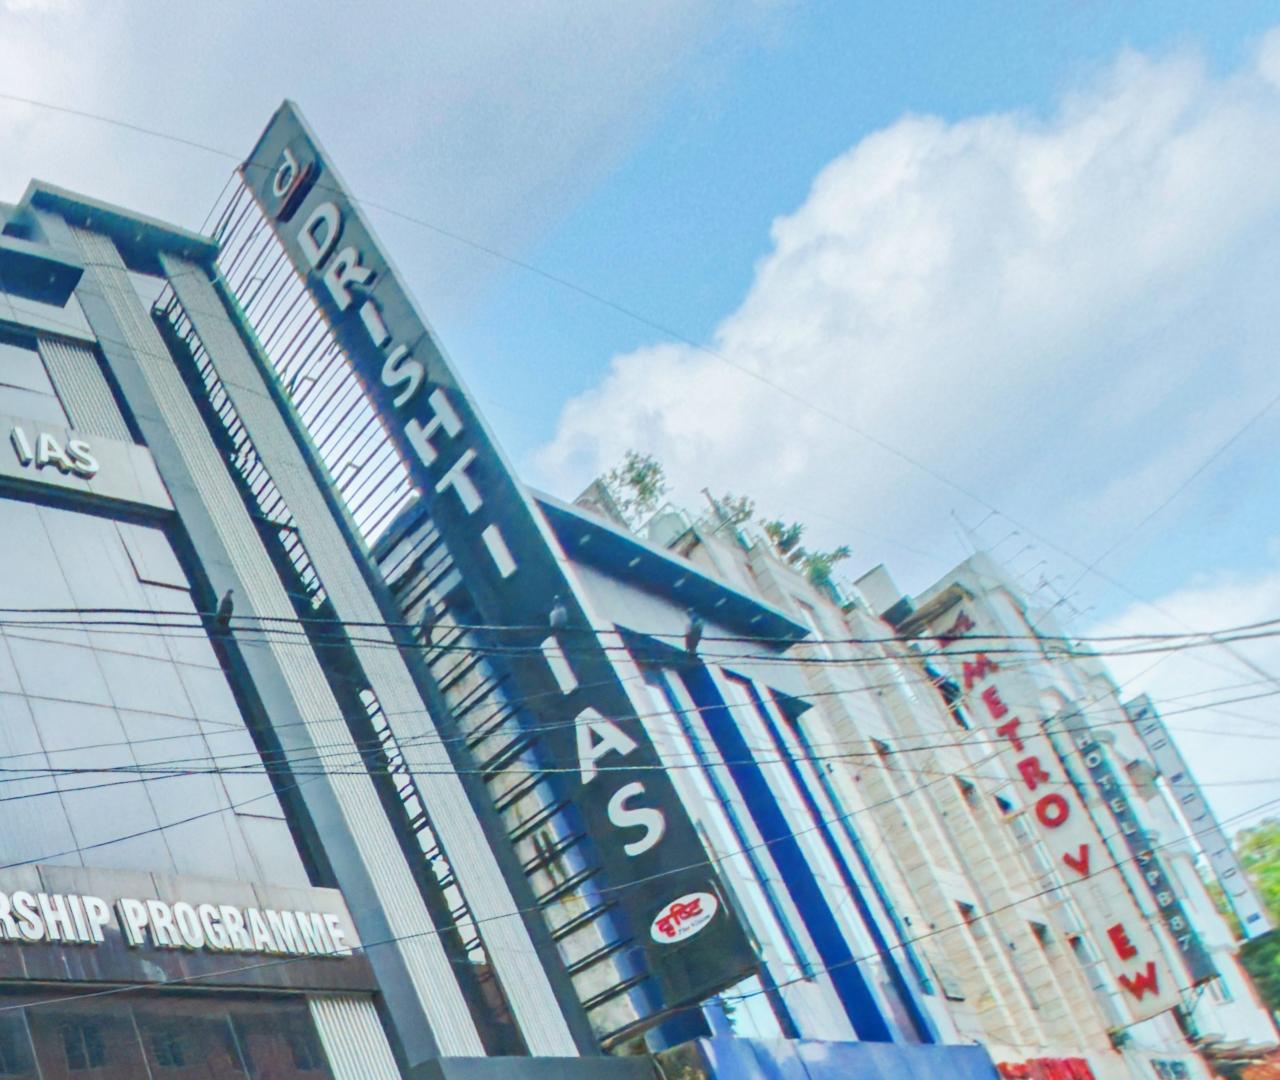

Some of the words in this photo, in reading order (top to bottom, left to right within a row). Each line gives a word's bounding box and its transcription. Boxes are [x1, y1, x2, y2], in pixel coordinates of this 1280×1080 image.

[10, 425, 100, 481] IAS
[297, 202, 519, 579] DRISHTI
[541, 635, 666, 858] IAS
[962, 652, 1070, 827] METRO
[117, 897, 353, 957] PROGRAMME
